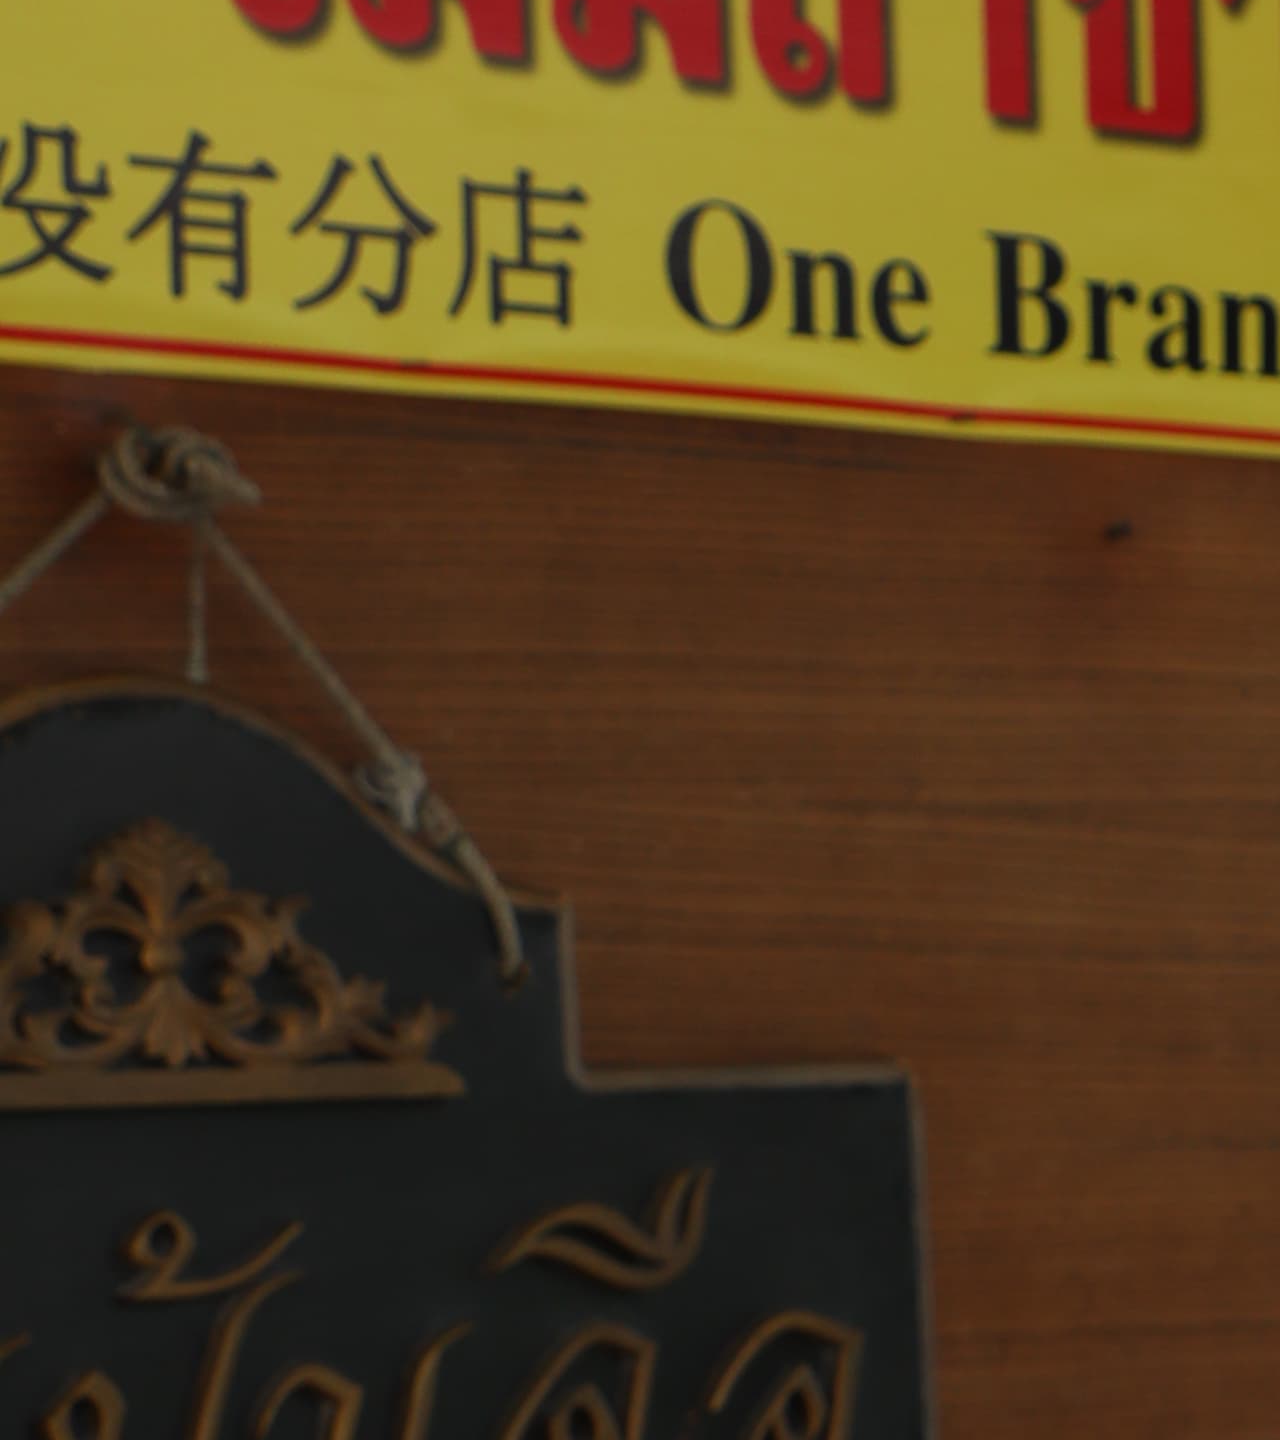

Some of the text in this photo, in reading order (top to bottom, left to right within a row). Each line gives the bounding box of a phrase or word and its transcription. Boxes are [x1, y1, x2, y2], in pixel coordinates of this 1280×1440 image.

[0, 119, 590, 328] 没有分店
[665, 197, 931, 350] One
